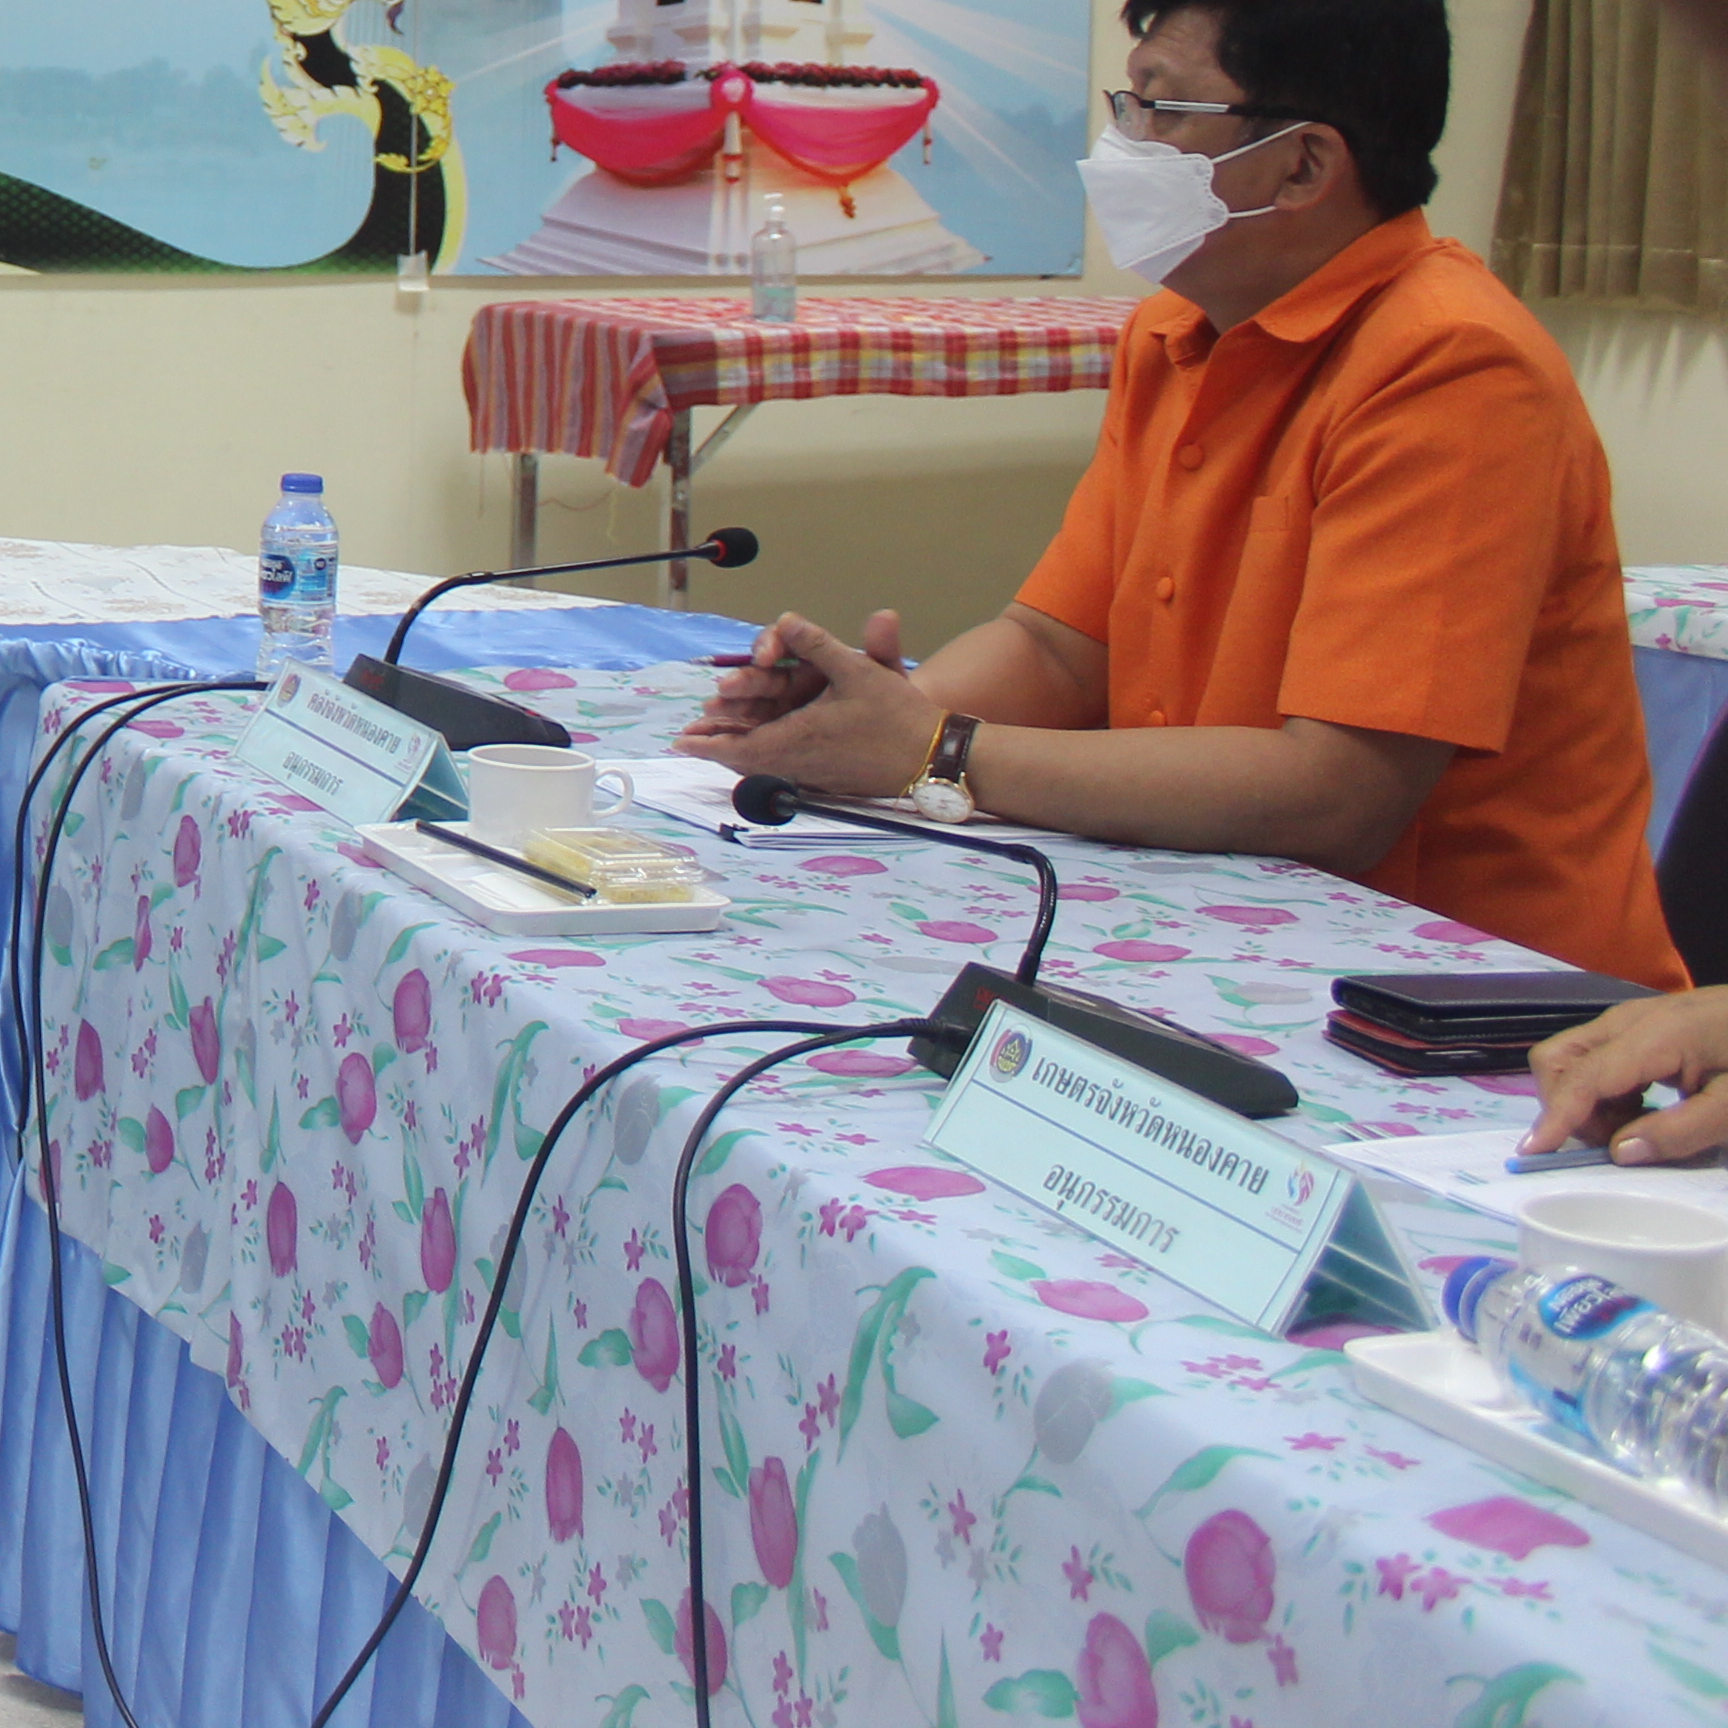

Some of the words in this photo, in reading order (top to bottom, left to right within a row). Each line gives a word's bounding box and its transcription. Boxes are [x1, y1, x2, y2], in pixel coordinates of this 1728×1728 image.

[1030, 1054, 1269, 1196] เกษตรจังหวัดหนองคาย
[1042, 1162, 1182, 1255] อนุกรรมการ
